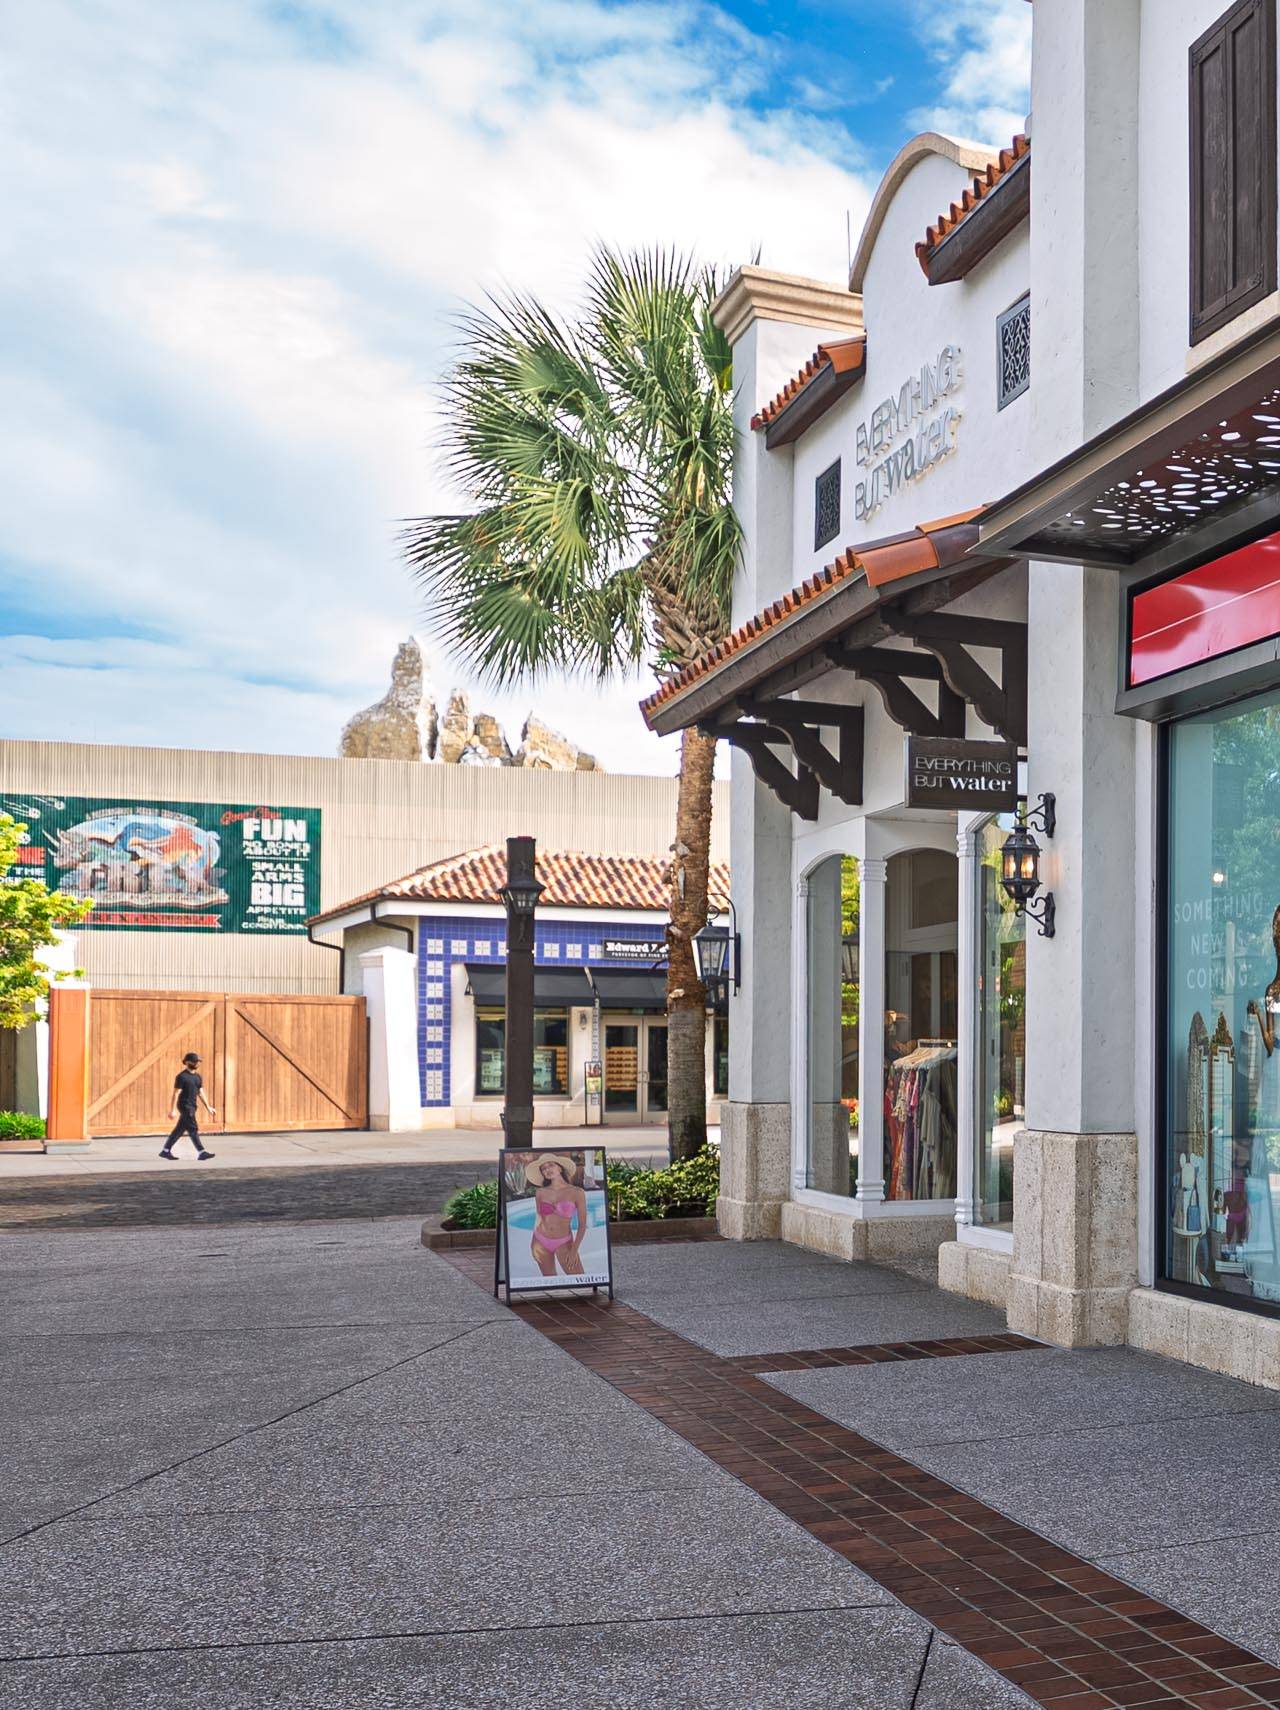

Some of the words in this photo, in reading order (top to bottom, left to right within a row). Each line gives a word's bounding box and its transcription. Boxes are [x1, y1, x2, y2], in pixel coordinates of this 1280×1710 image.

[856, 344, 960, 467] EVERYTHING
[855, 463, 884, 521] BUT
[885, 406, 960, 497] water
[914, 756, 1012, 775] EVERYTHING
[914, 775, 946, 788] BUT
[949, 776, 1012, 792] water
[243, 818, 307, 841] FUN
[252, 861, 304, 872] SMALL
[252, 872, 305, 883] ARMS
[251, 882, 305, 906] BIG
[246, 905, 307, 915] APPETITE
[1174, 892, 1264, 922] SOMETHING
[1186, 966, 1248, 989] COMING
[575, 1275, 608, 1284] water
